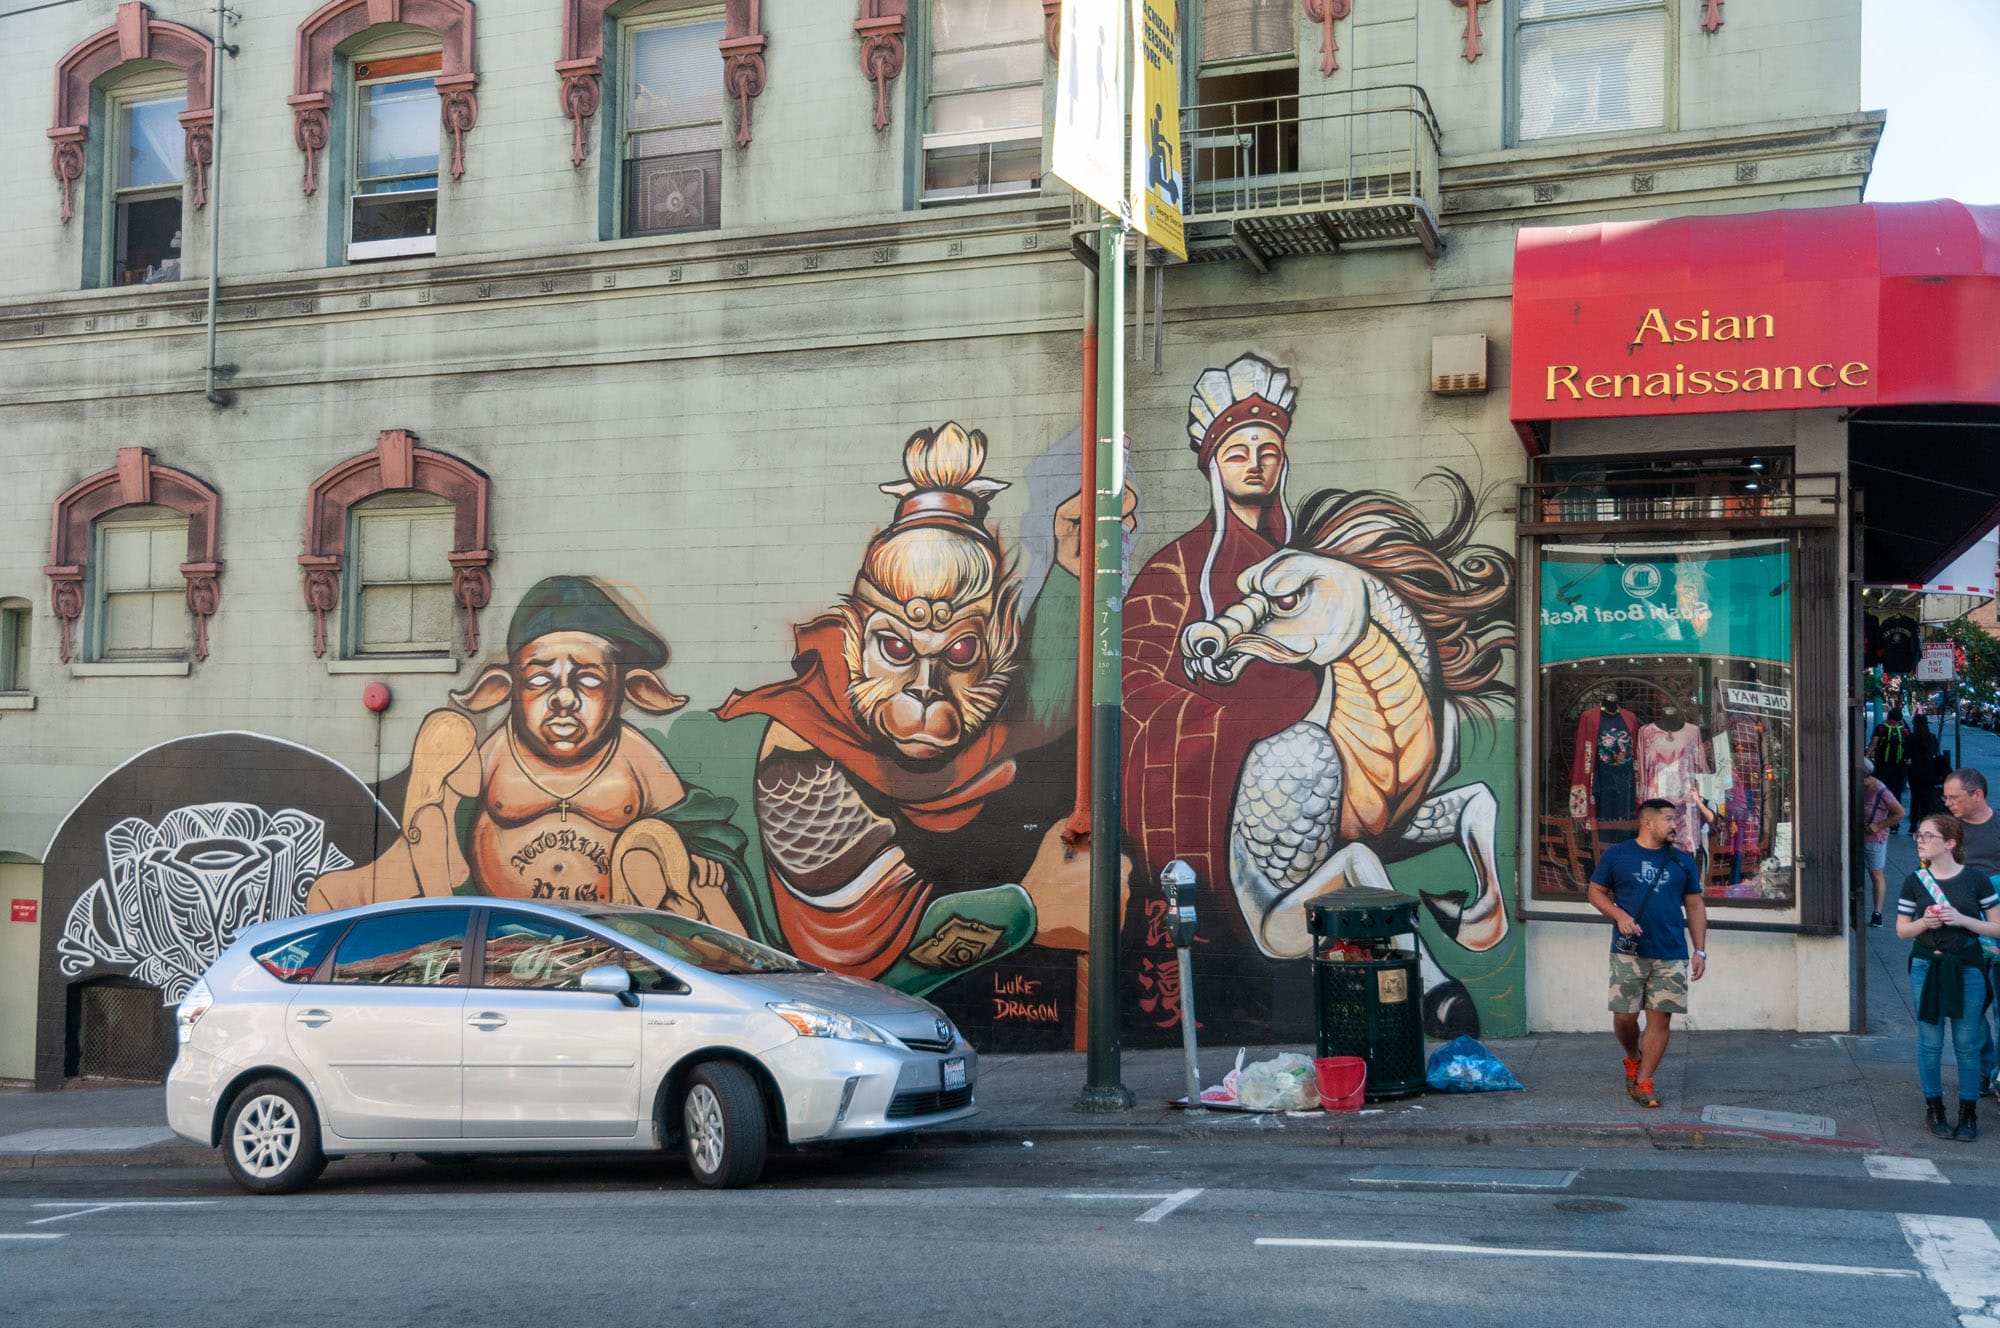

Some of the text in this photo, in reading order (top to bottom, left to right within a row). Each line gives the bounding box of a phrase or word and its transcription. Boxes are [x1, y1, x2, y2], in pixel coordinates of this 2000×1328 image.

[1148, 6, 1169, 41] CRUZAR
[1143, 42, 1161, 71] YORES
[1145, 22, 1173, 65] PERSONAS
[1632, 308, 1774, 345] Asian
[1546, 361, 1869, 400] Renaissance
[995, 971, 1041, 994] LUKE
[992, 998, 1058, 1022] DRAGON
